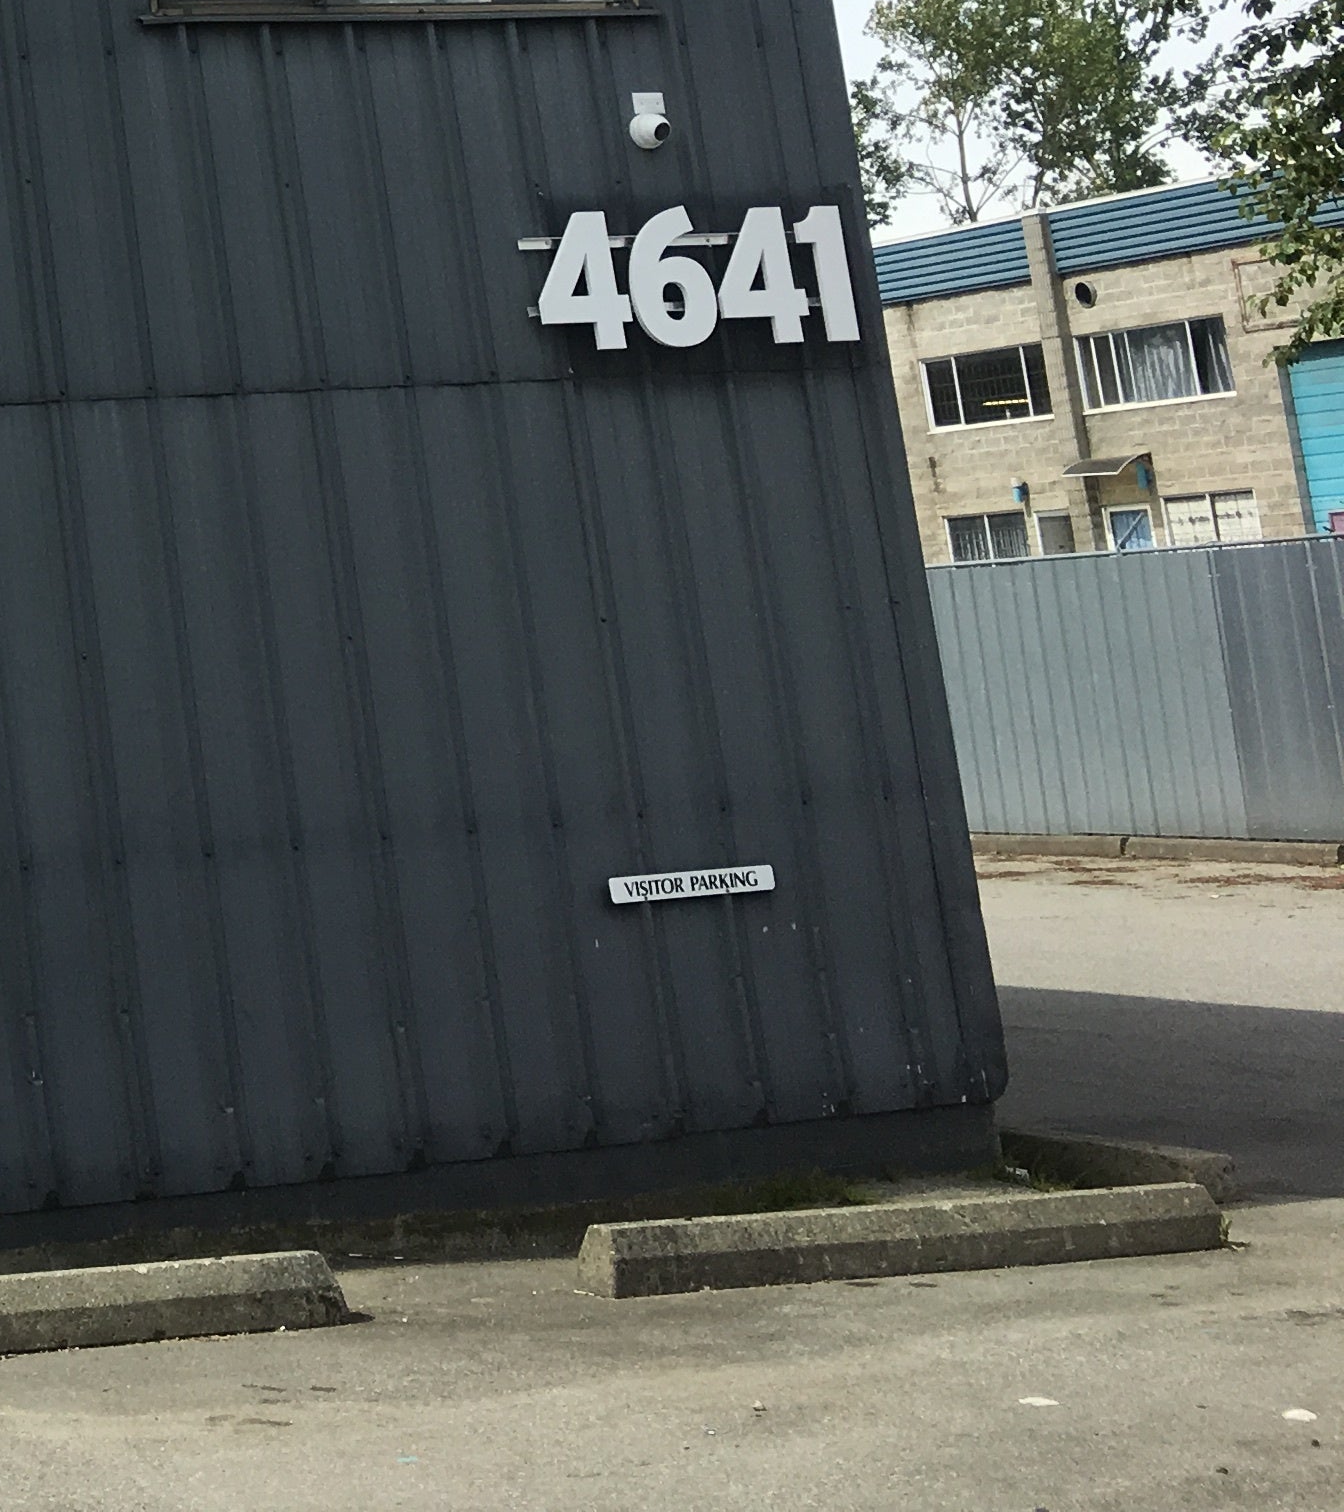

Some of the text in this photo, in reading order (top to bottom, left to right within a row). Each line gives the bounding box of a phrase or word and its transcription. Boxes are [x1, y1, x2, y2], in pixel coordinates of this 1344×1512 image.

[538, 204, 862, 352] 4641
[623, 870, 759, 898] VISITOR PARKING
